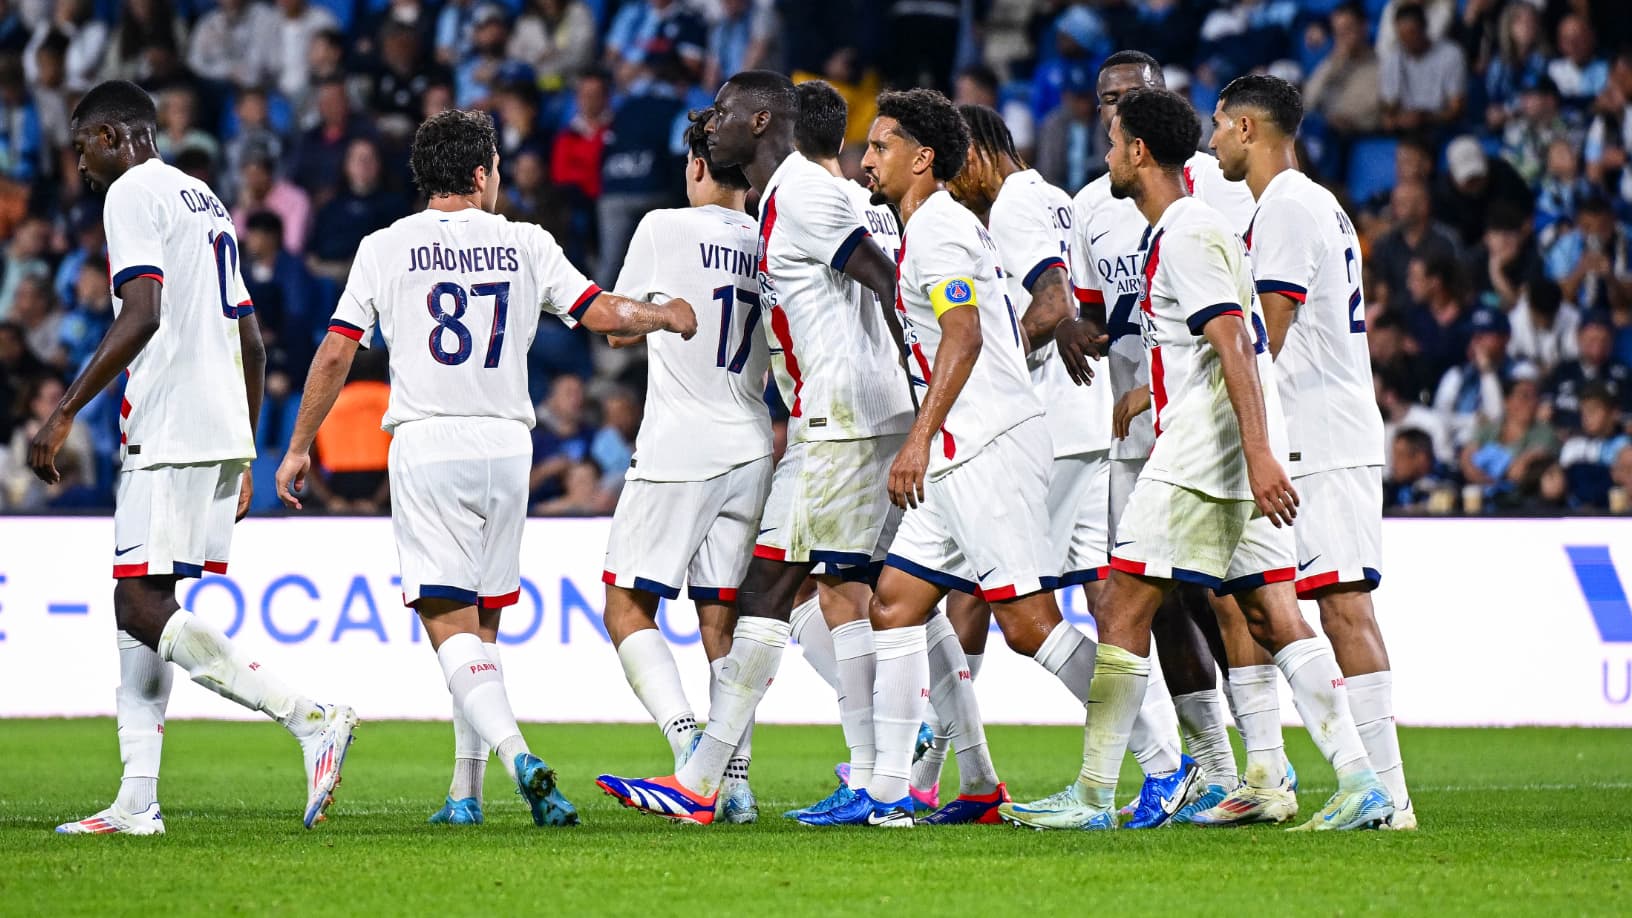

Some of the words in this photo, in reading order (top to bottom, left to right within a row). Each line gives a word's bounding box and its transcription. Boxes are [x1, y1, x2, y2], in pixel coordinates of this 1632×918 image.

[408, 242, 457, 272] JOÃO
[458, 246, 519, 274] NEVES
[427, 281, 510, 369] 87
[713, 284, 761, 374] 17
